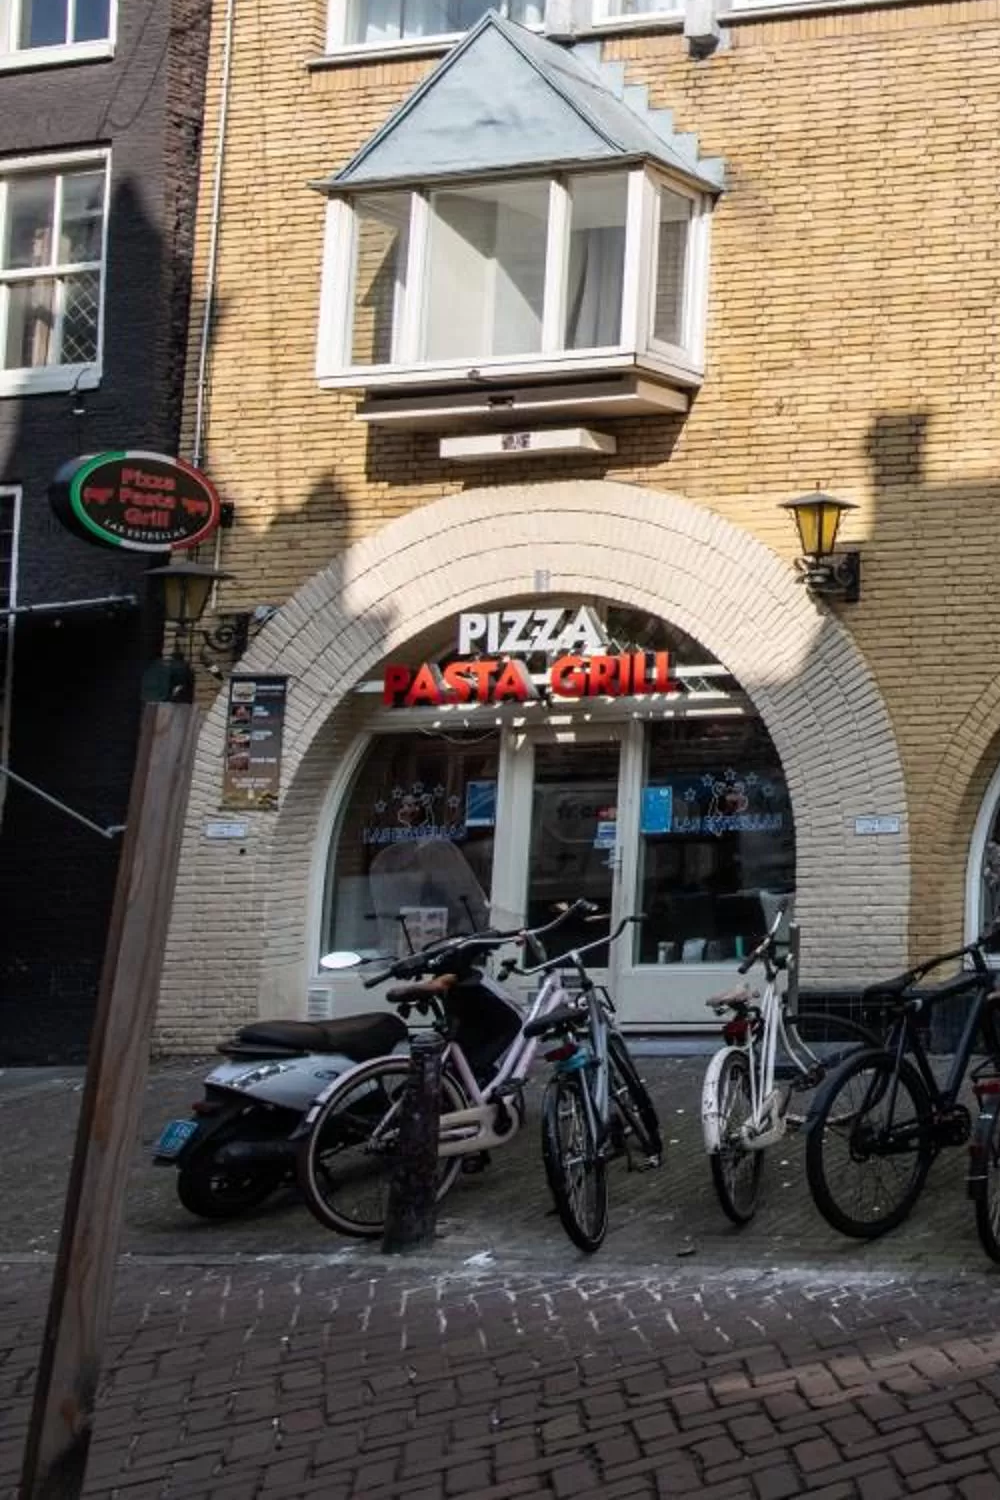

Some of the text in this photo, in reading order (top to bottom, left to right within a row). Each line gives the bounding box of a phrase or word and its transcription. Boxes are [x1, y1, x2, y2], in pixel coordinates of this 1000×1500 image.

[121, 468, 176, 489] Pizza
[119, 488, 176, 508] Pasta
[124, 508, 169, 526] Grill
[459, 605, 606, 654] PIZZA
[384, 650, 678, 708] PASTA GRILL
